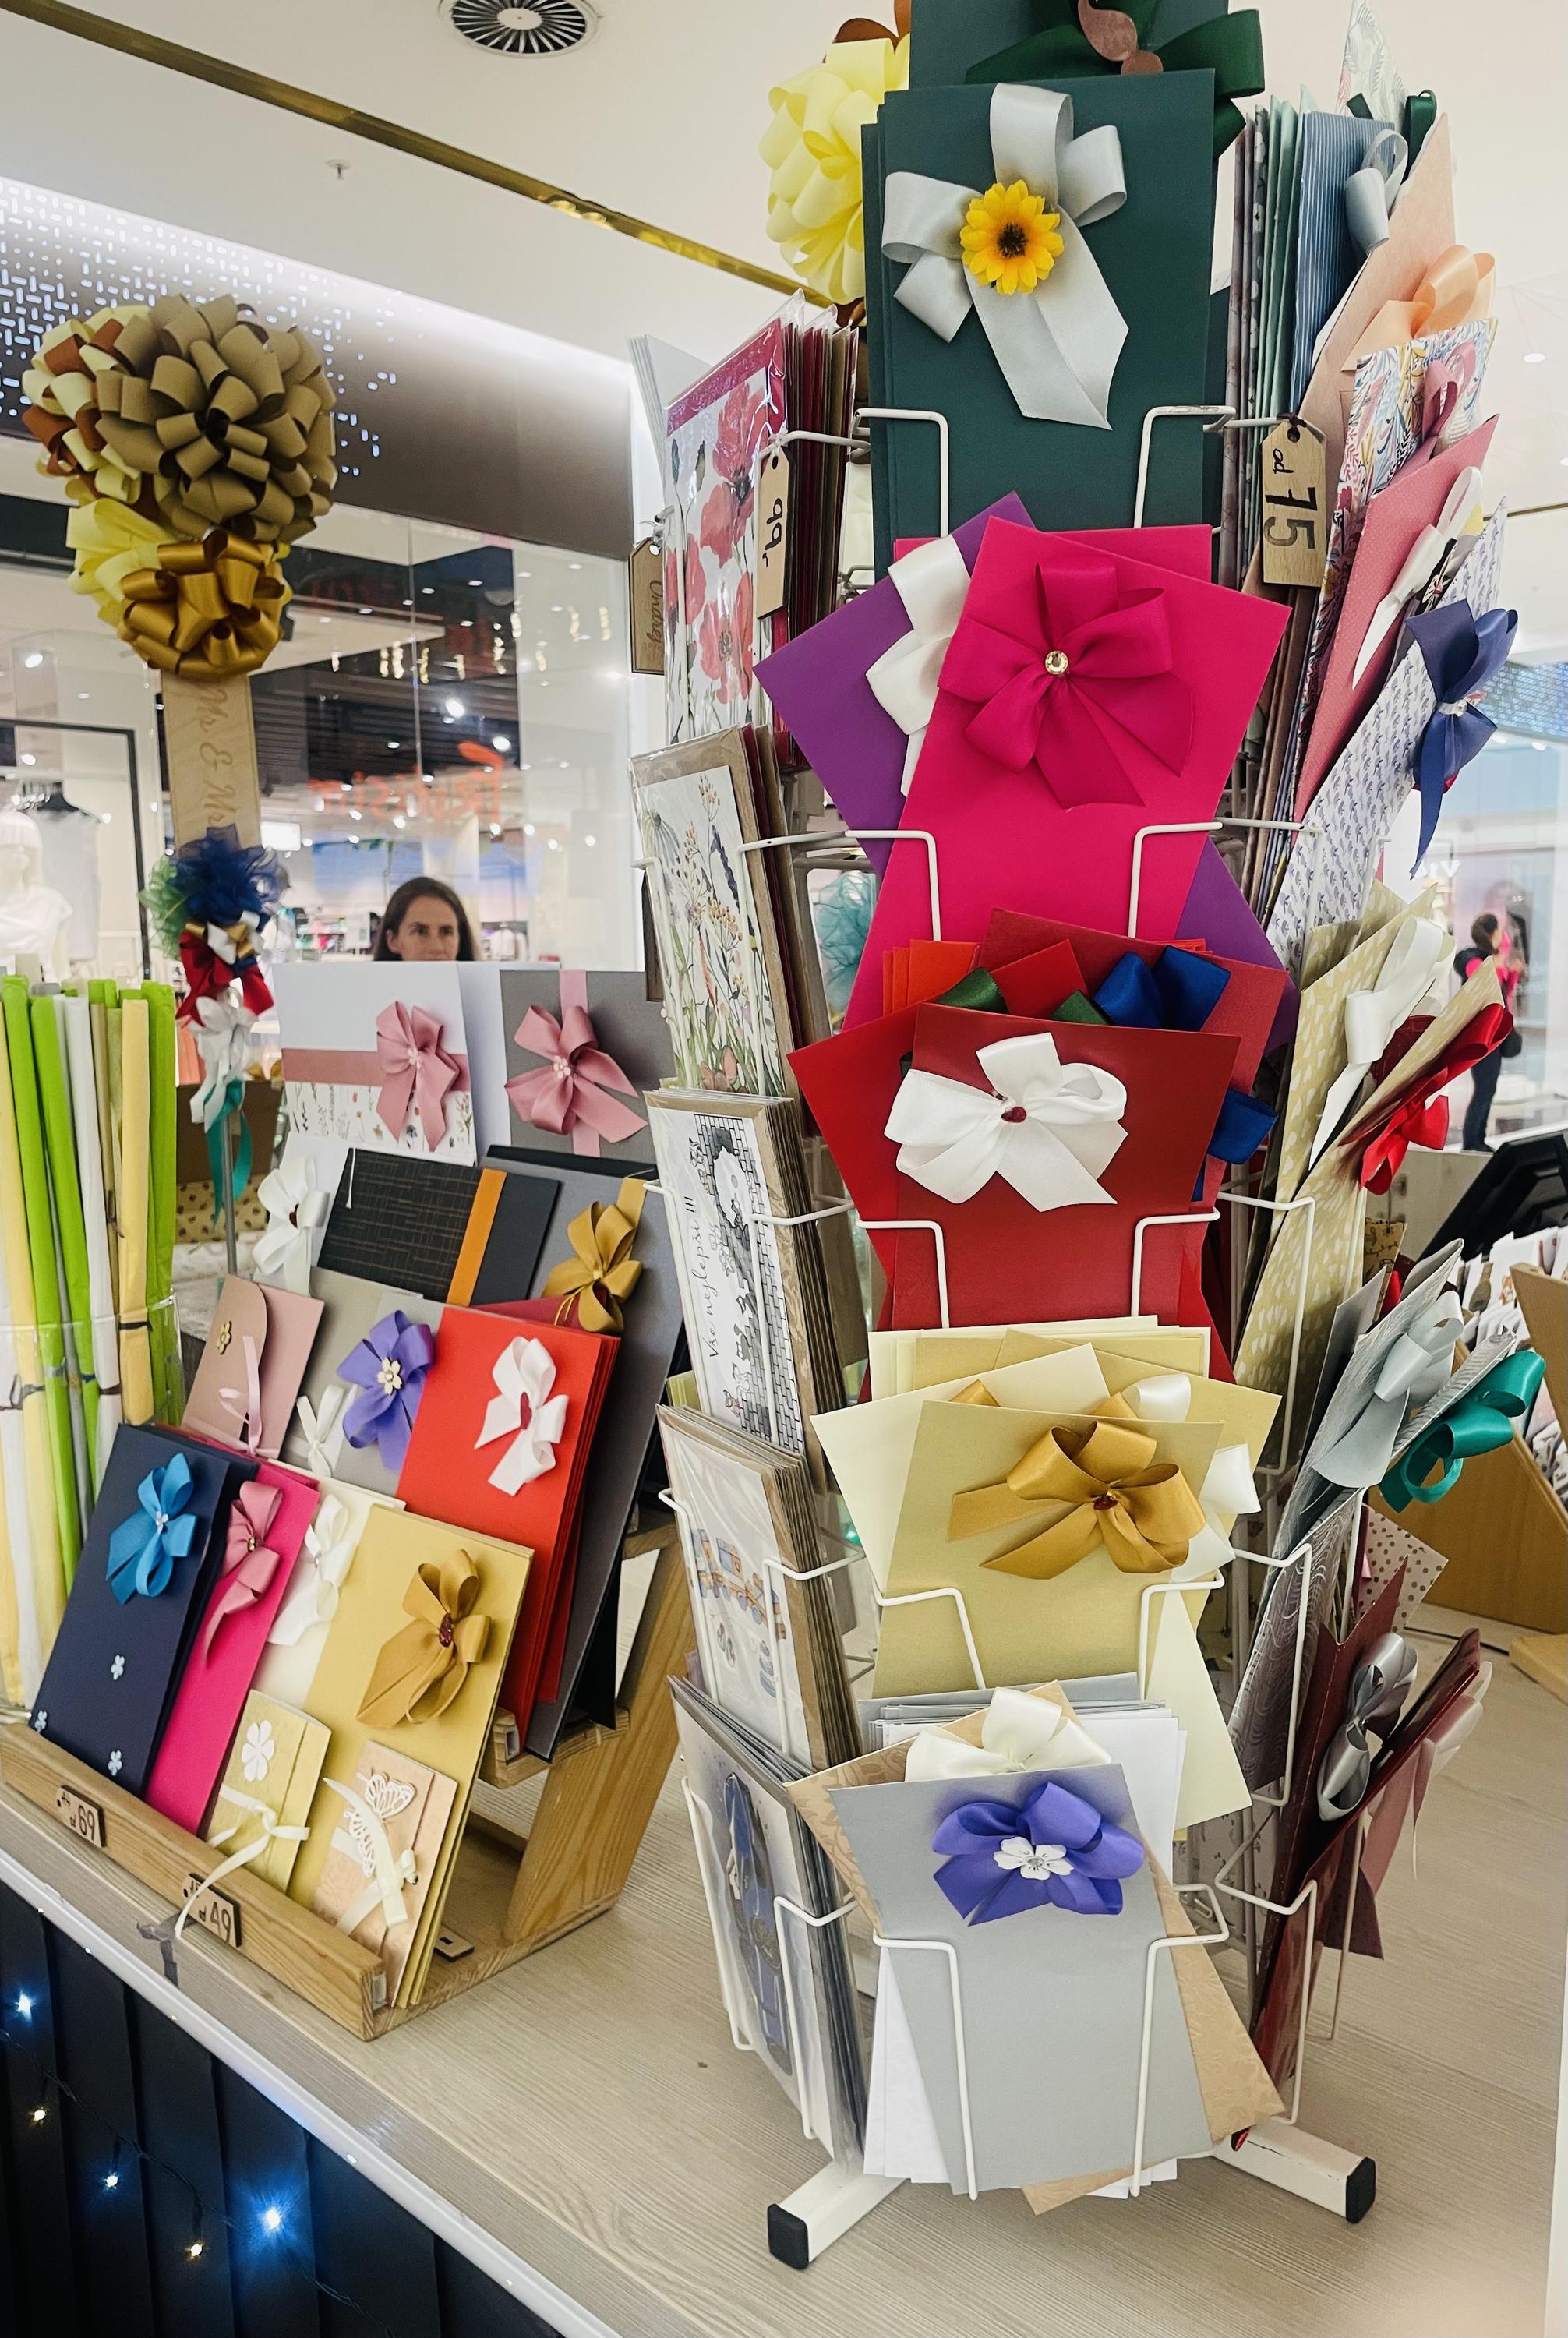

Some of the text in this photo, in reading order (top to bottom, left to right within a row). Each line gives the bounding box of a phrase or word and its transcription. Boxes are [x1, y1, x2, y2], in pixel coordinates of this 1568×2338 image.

[1264, 448, 1318, 550] od 75
[196, 689, 237, 825] Mr & Mr
[78, 1804, 96, 1841] 69
[210, 1901, 231, 1943] 49
